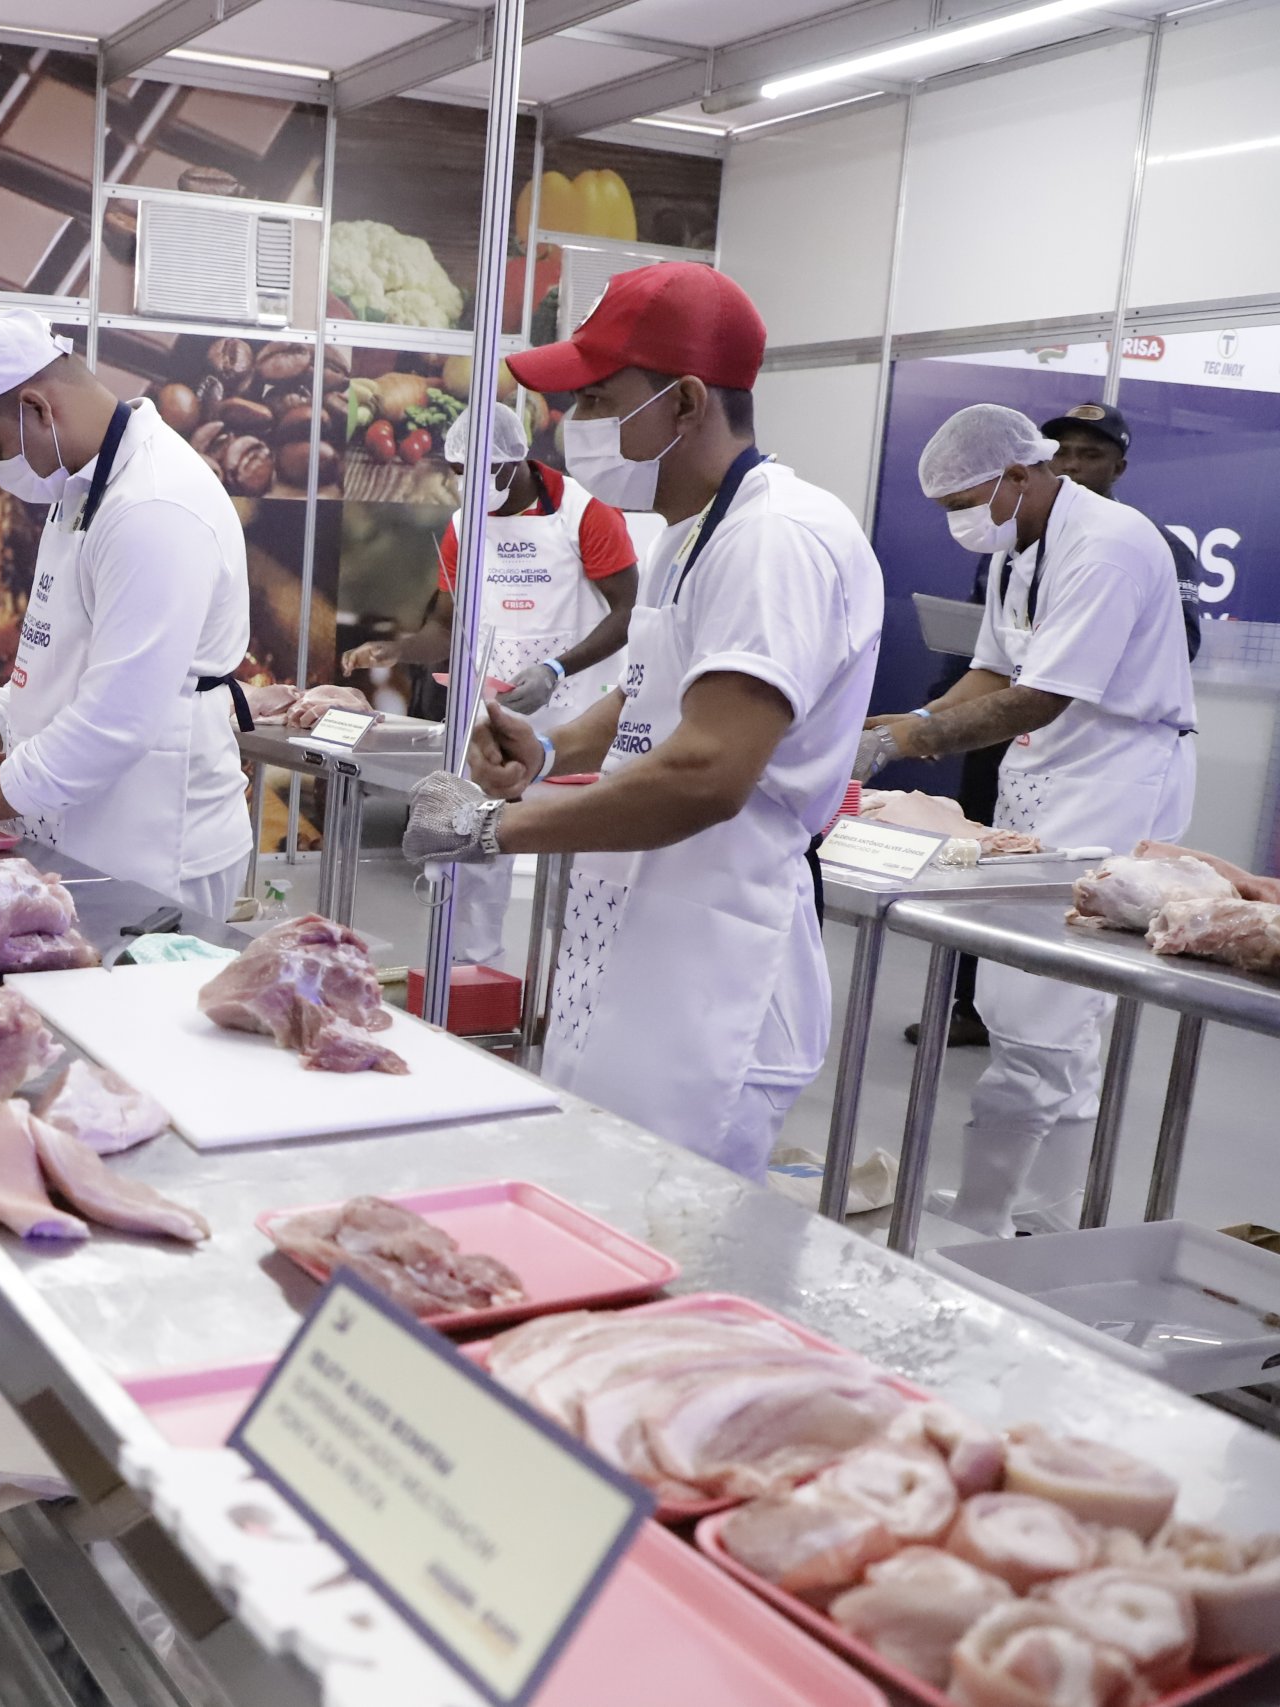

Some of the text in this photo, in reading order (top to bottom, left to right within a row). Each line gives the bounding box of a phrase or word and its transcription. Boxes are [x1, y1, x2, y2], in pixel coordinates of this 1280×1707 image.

[1122, 338, 1161, 358] RISA
[1204, 361, 1245, 377] TEC INOX
[497, 542, 537, 553] ACAPS
[486, 574, 552, 584] AÇOUGUEIRO
[504, 601, 534, 610] FRISA
